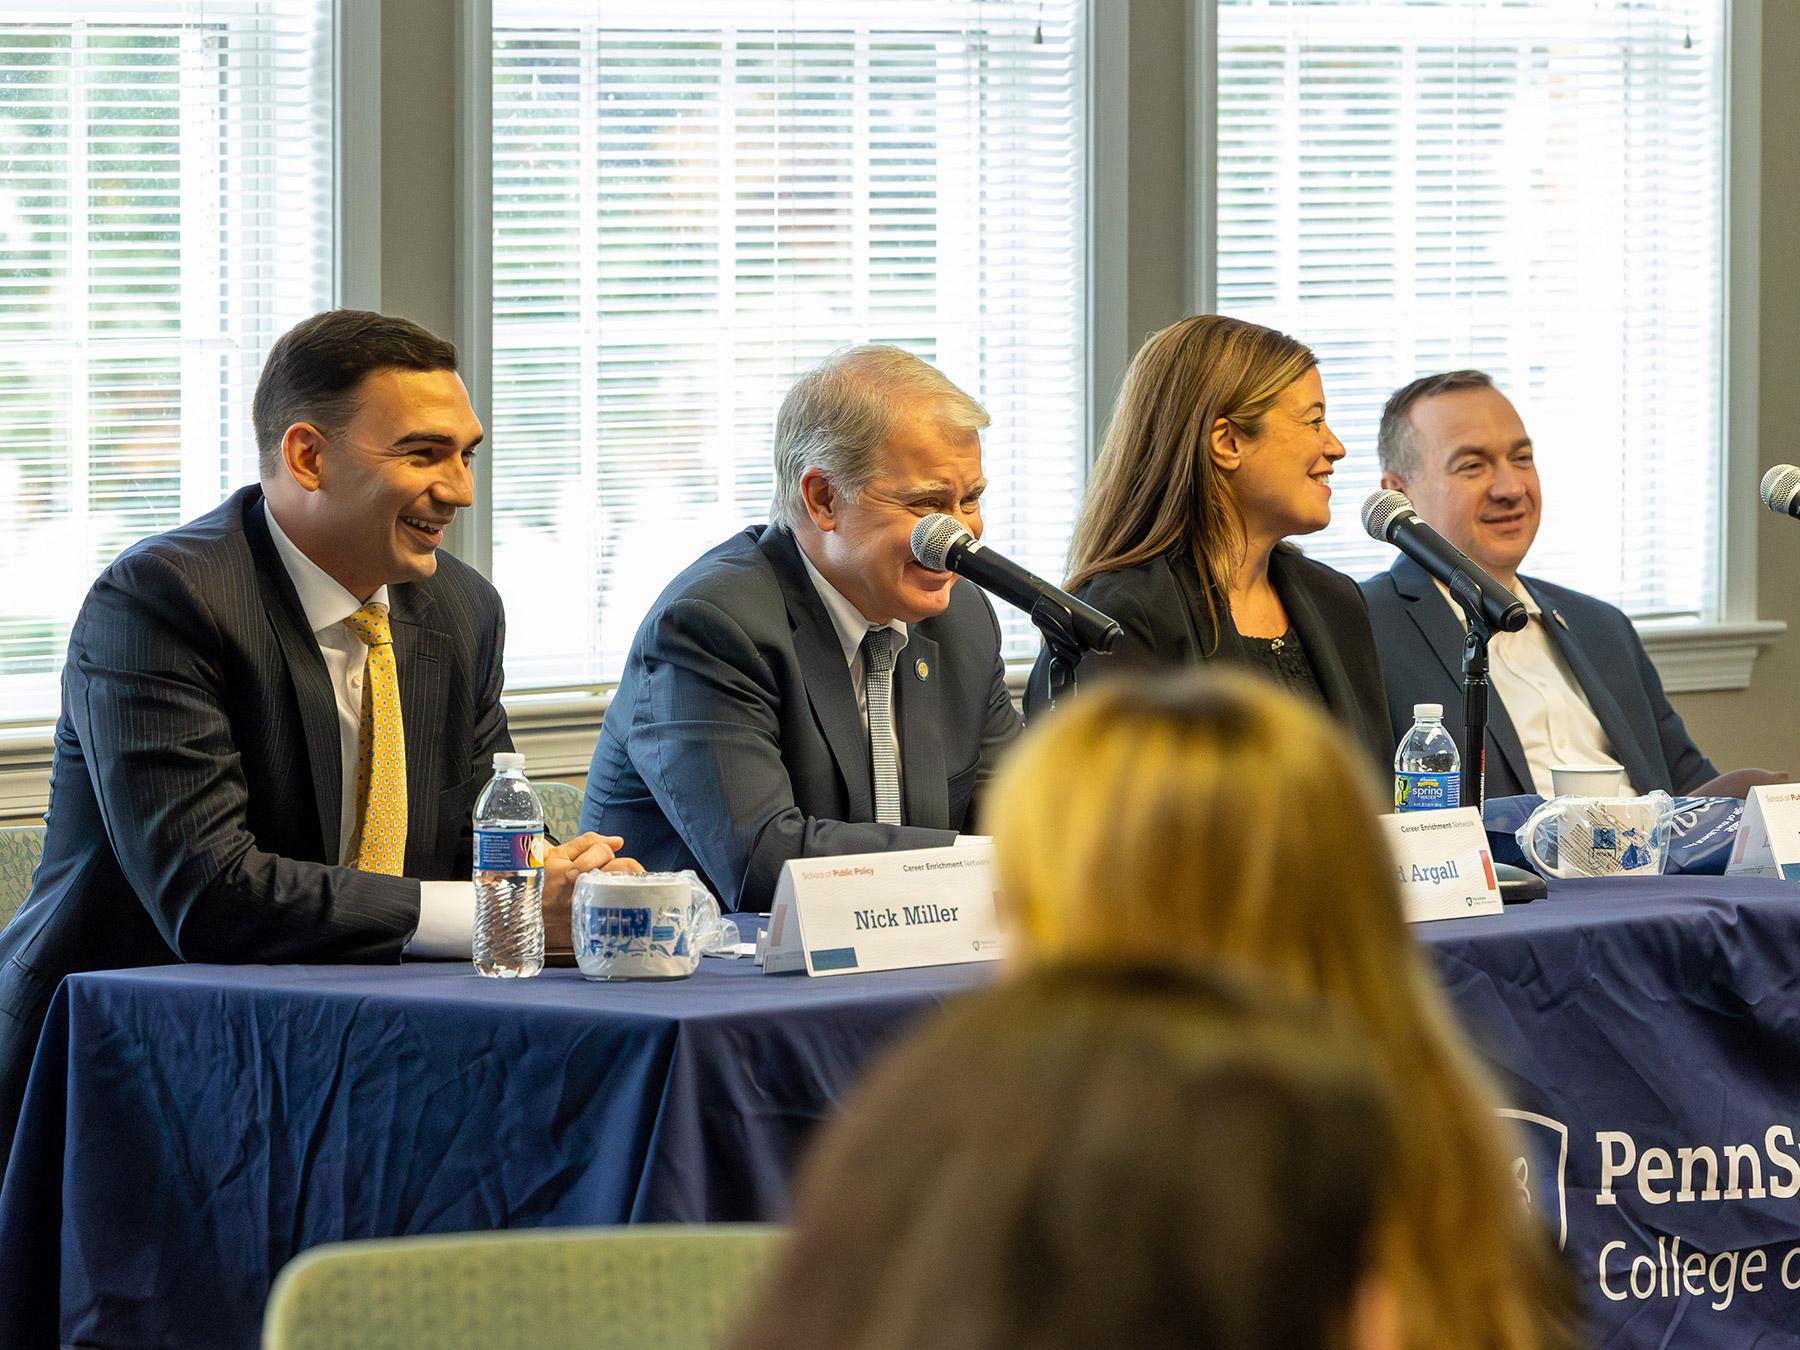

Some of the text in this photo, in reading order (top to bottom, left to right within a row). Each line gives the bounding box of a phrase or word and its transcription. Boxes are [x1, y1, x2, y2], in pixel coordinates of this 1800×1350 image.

[1412, 786, 1443, 798] spring
[1400, 820, 1475, 833] Career Enrichment Network
[802, 867, 874, 880] School of Public Policy
[903, 863, 925, 872] Career
[926, 860, 963, 871] Enrichment
[1411, 860, 1460, 885] Argall
[854, 904, 959, 931] Nick Miller
[1595, 1124, 1800, 1206] PennS
[1599, 1235, 1767, 1311] College
